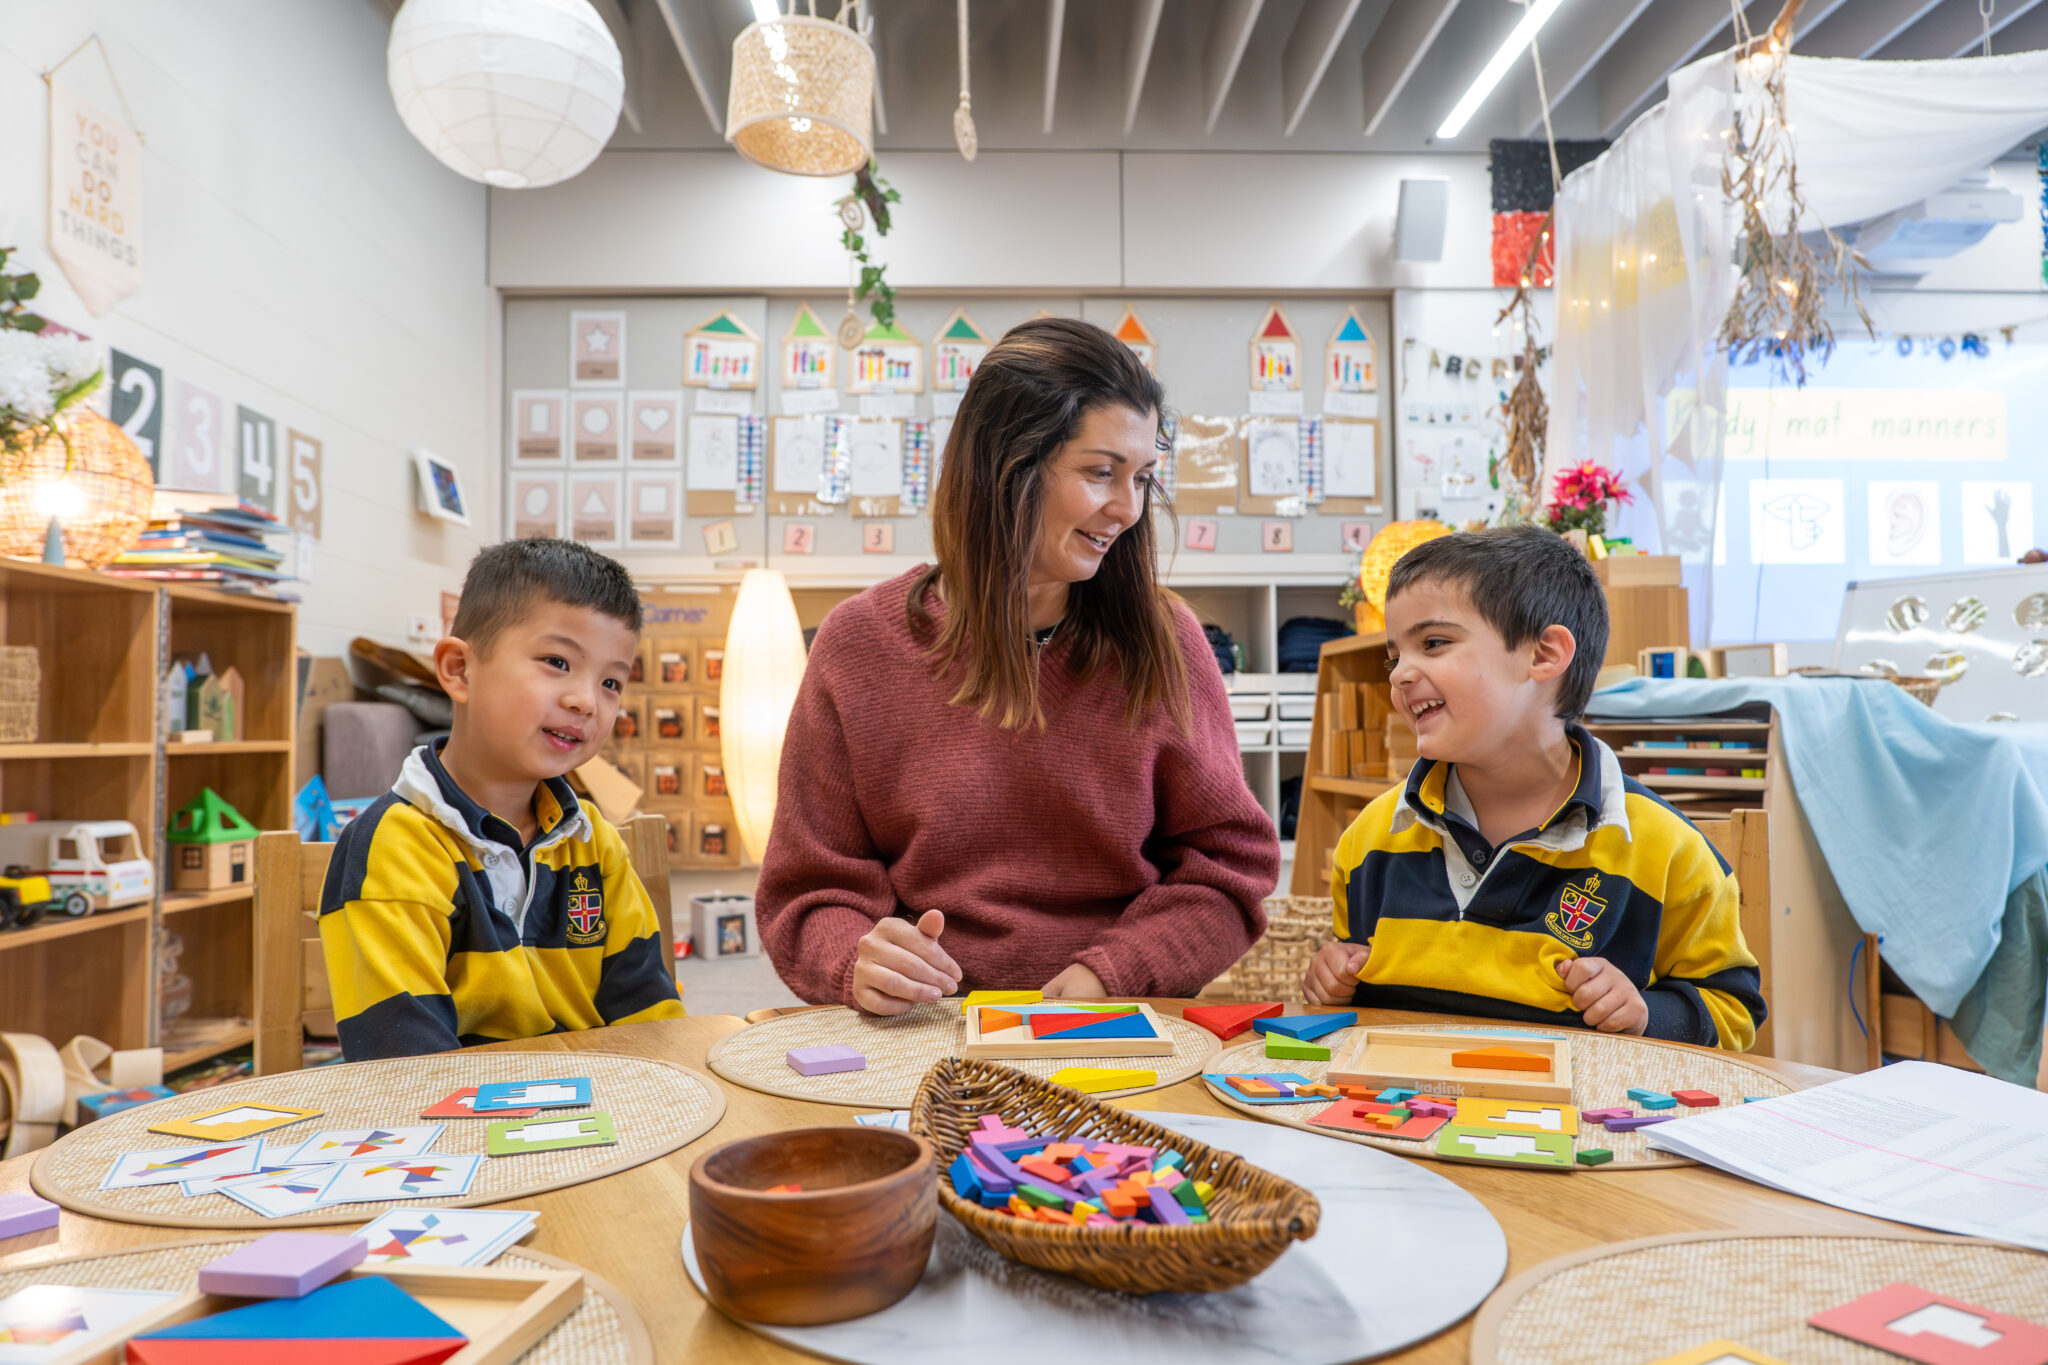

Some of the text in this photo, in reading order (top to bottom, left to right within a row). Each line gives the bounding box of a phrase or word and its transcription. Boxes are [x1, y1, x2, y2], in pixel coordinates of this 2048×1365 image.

[75, 112, 118, 155] YOU
[75, 142, 118, 180] CAN
[83, 170, 112, 203] DO
[69, 187, 125, 235] HARD
[58, 209, 137, 267] THINGS
[119, 367, 157, 458] 2
[1785, 399, 1841, 437] mat
[1870, 416, 1998, 438] manners
[185, 396, 213, 476] 3
[243, 421, 272, 496] 4
[293, 438, 319, 513] 5
[793, 528, 805, 546] 2
[872, 528, 883, 546] 3
[1197, 525, 1207, 543] 7
[1415, 1081, 1465, 1097] kadink
